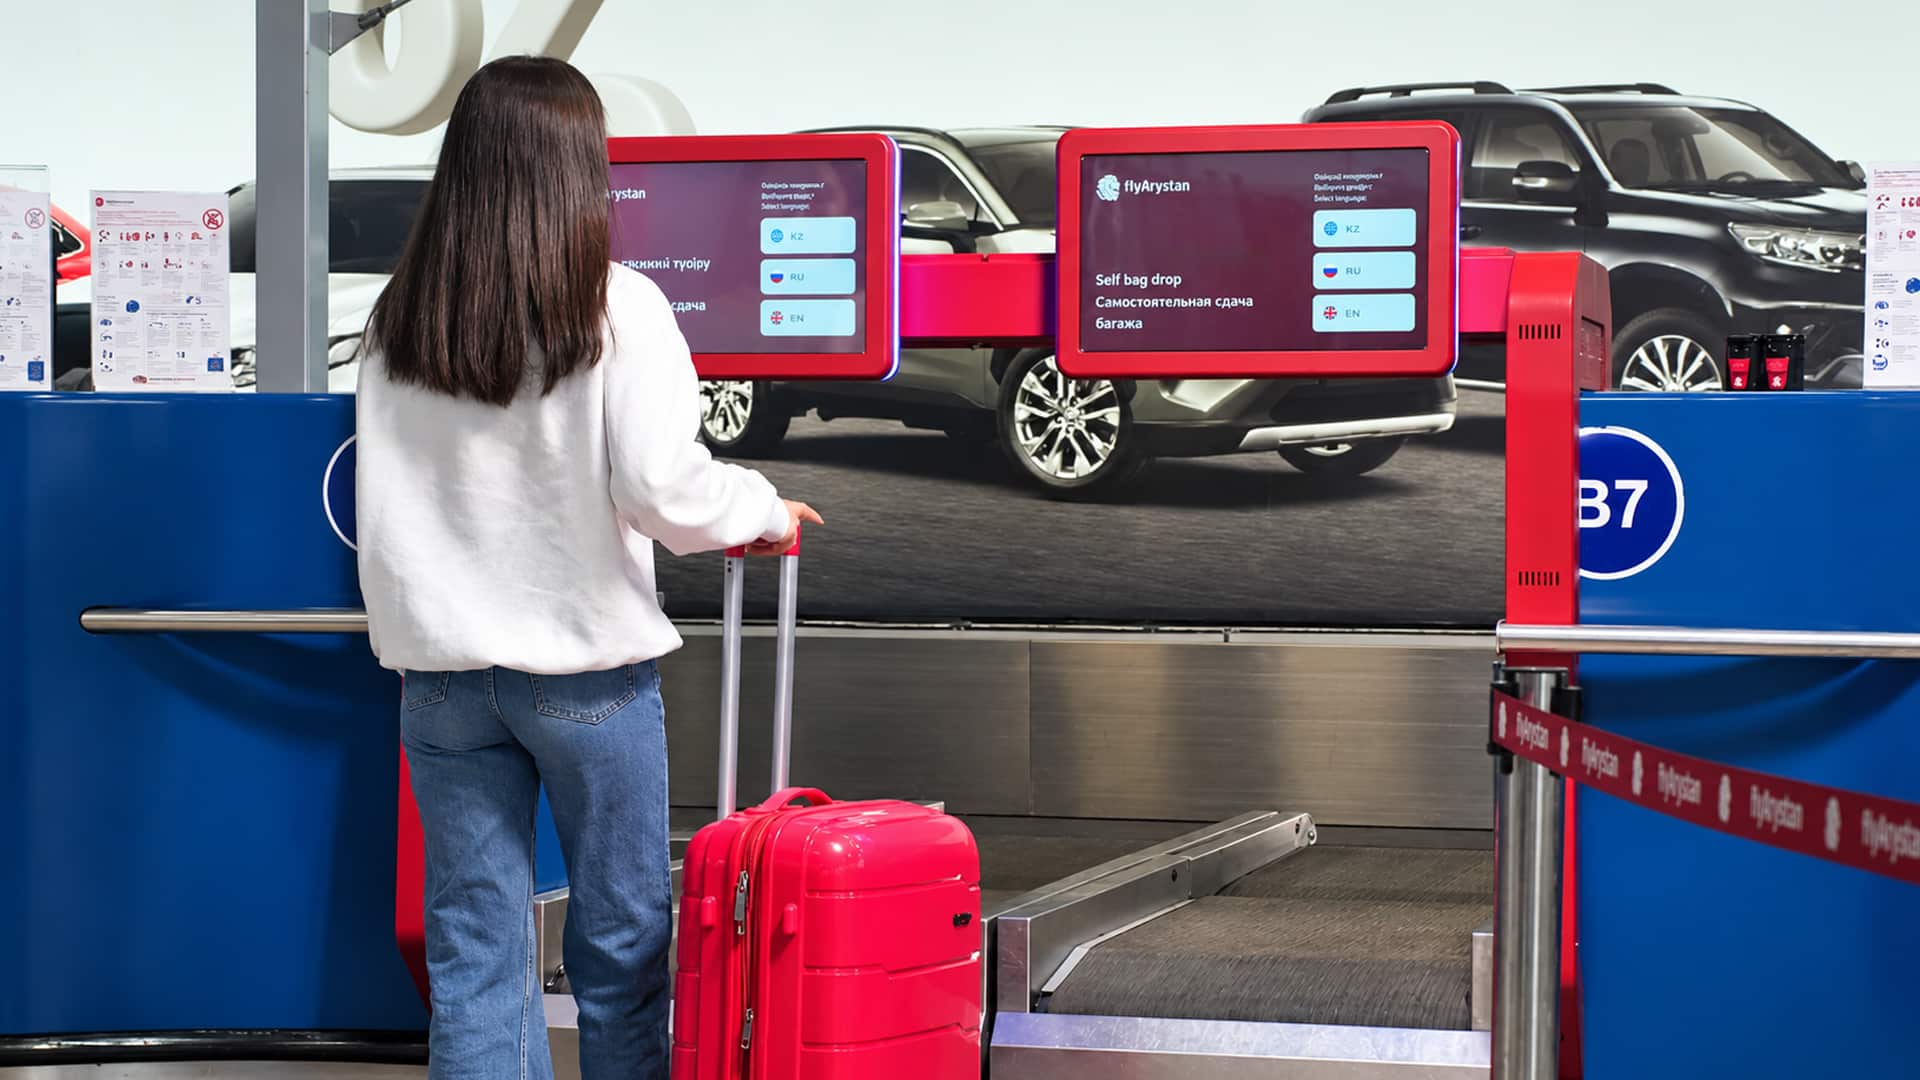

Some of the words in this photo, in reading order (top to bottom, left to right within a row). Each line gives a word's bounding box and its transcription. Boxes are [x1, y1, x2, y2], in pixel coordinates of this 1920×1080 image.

[1124, 179, 1190, 195] flyArystan
[1345, 225, 1360, 233] KZ
[790, 232, 804, 241] KZ
[1345, 267, 1361, 275] RU
[790, 273, 805, 281] RU
[1095, 273, 1120, 286] Self
[1124, 273, 1148, 289] bag
[1151, 273, 1182, 288] drop
[671, 301, 707, 313] сдача
[1095, 296, 1211, 308] Самостоятельная
[1215, 297, 1254, 309] сдача
[790, 314, 805, 323] EN
[1345, 309, 1360, 318] EN
[1095, 316, 1143, 329] багажа
[1578, 479, 1648, 529] B7
